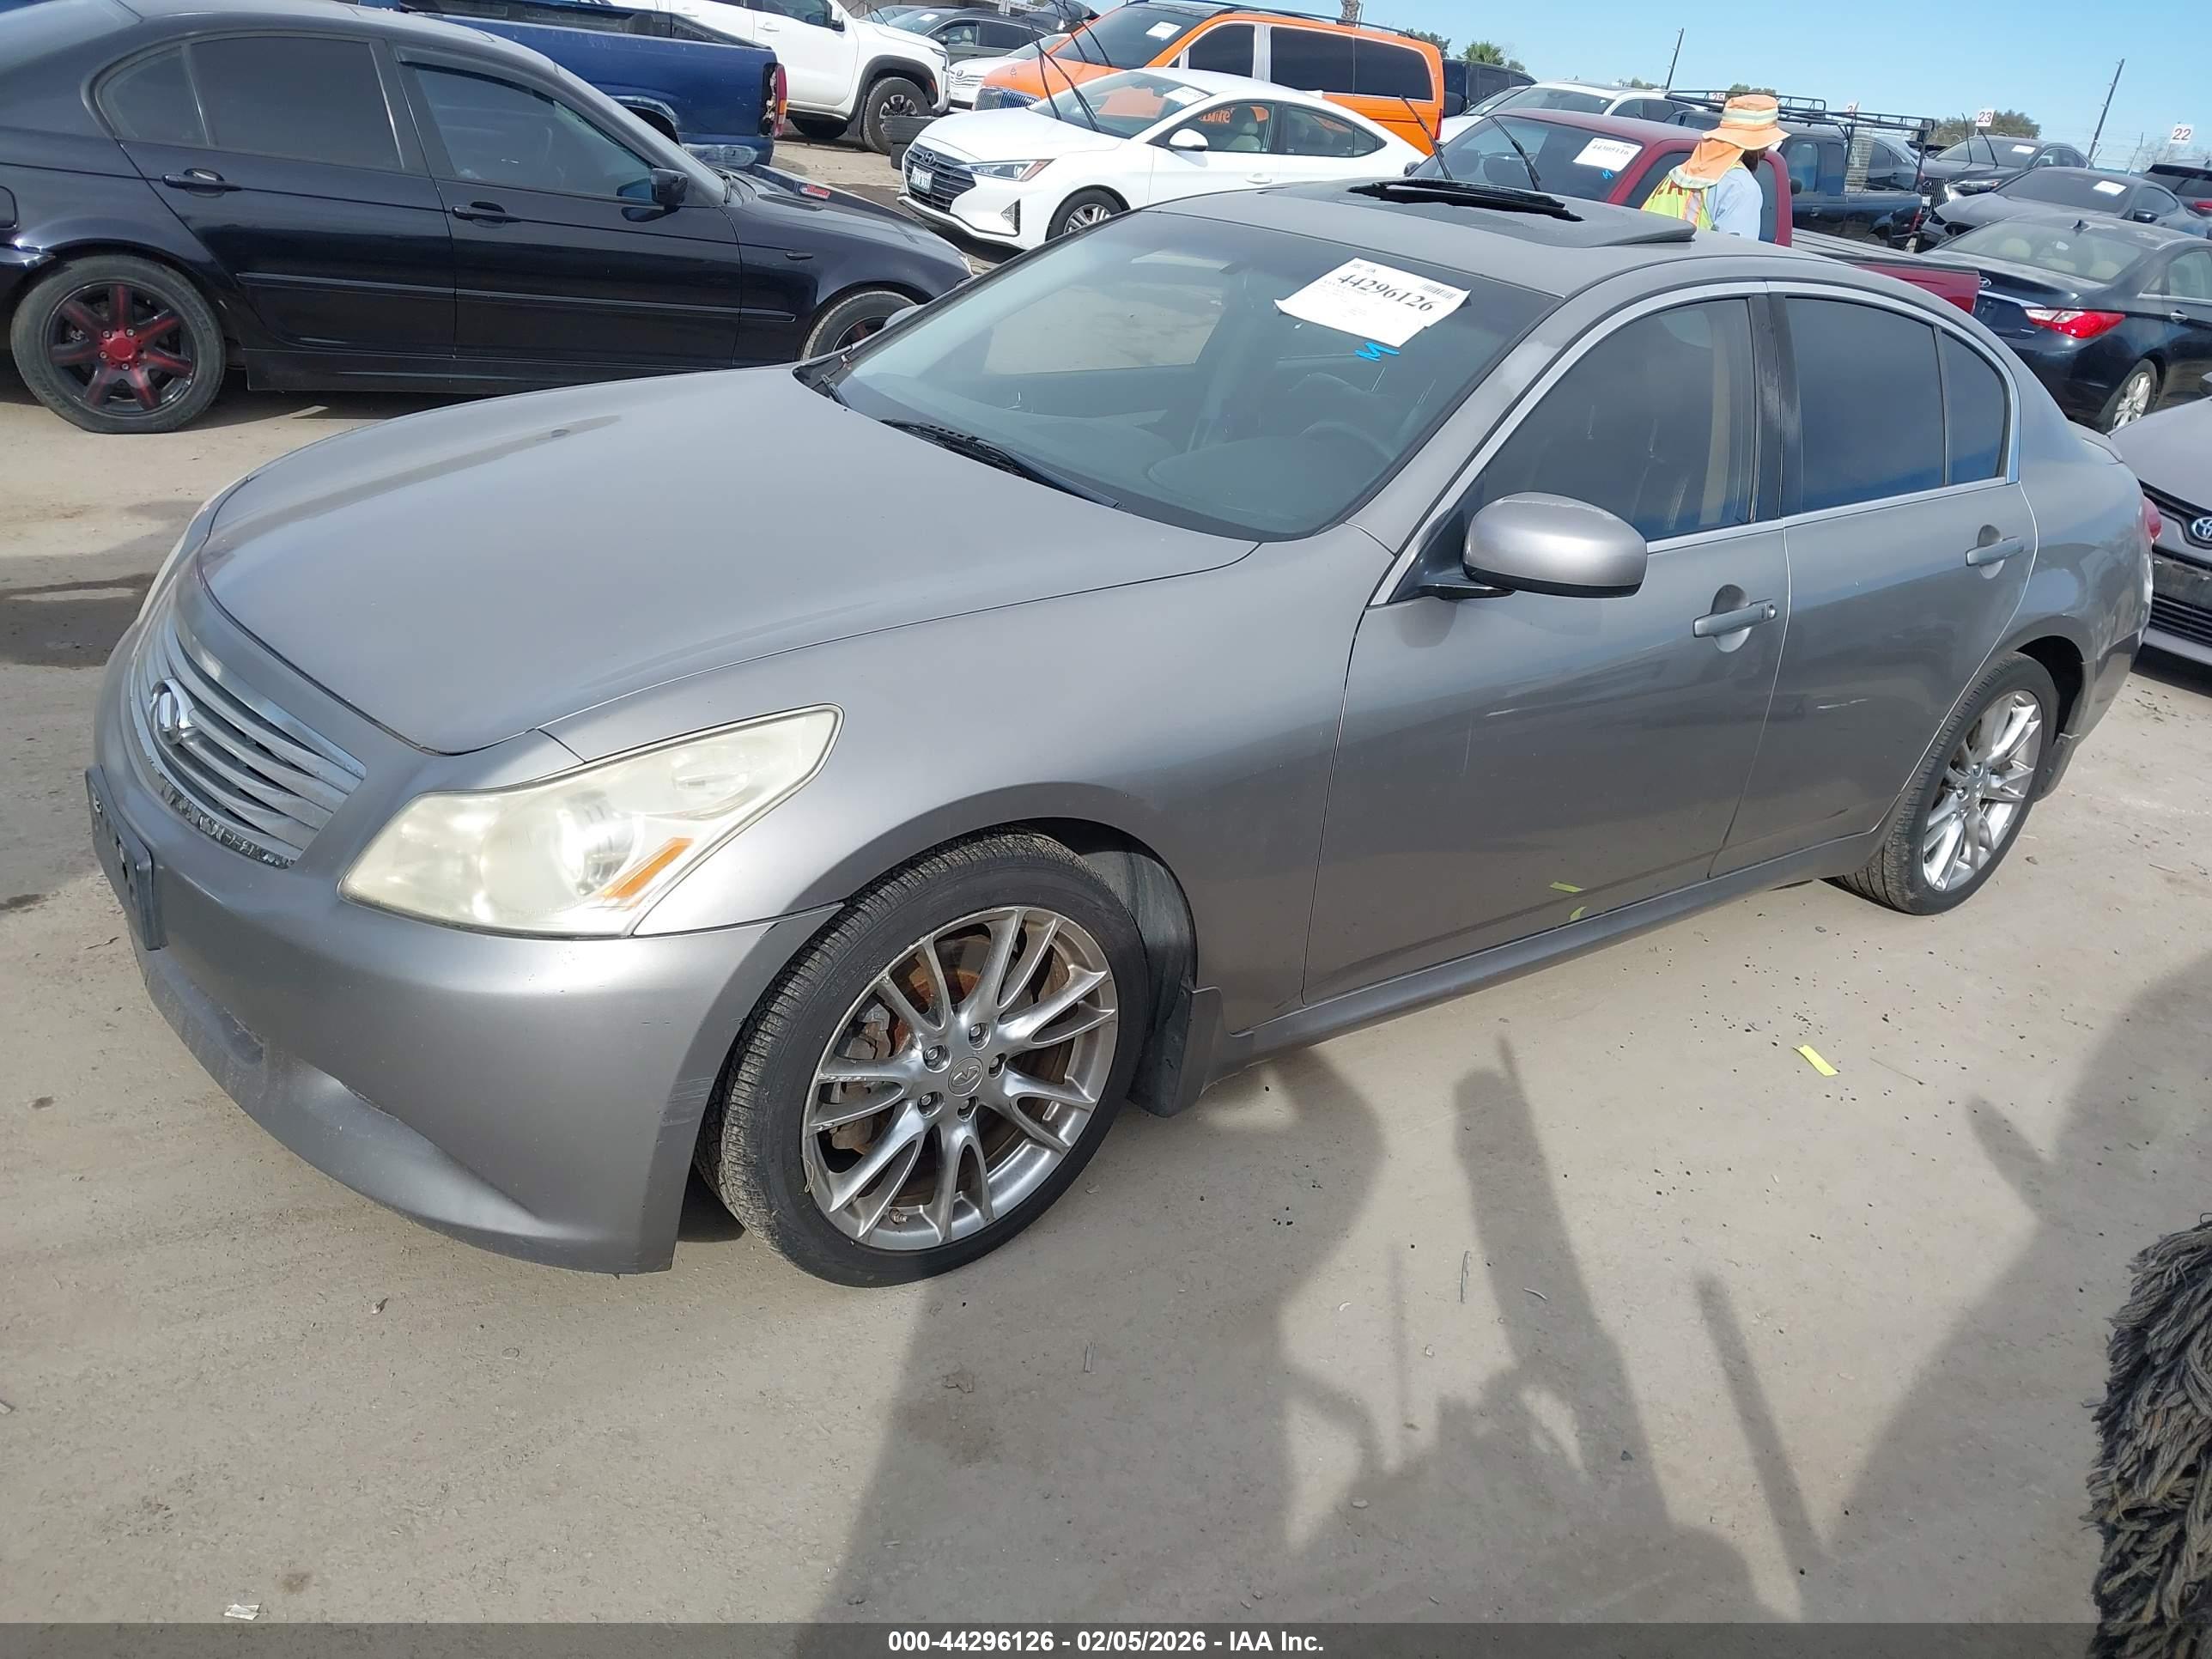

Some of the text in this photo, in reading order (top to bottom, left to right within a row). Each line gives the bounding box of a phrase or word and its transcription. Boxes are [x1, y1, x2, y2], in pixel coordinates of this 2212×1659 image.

[1978, 111, 1992, 123] 23
[2172, 128, 2191, 140] 22
[1337, 274, 1439, 313] 44296126
